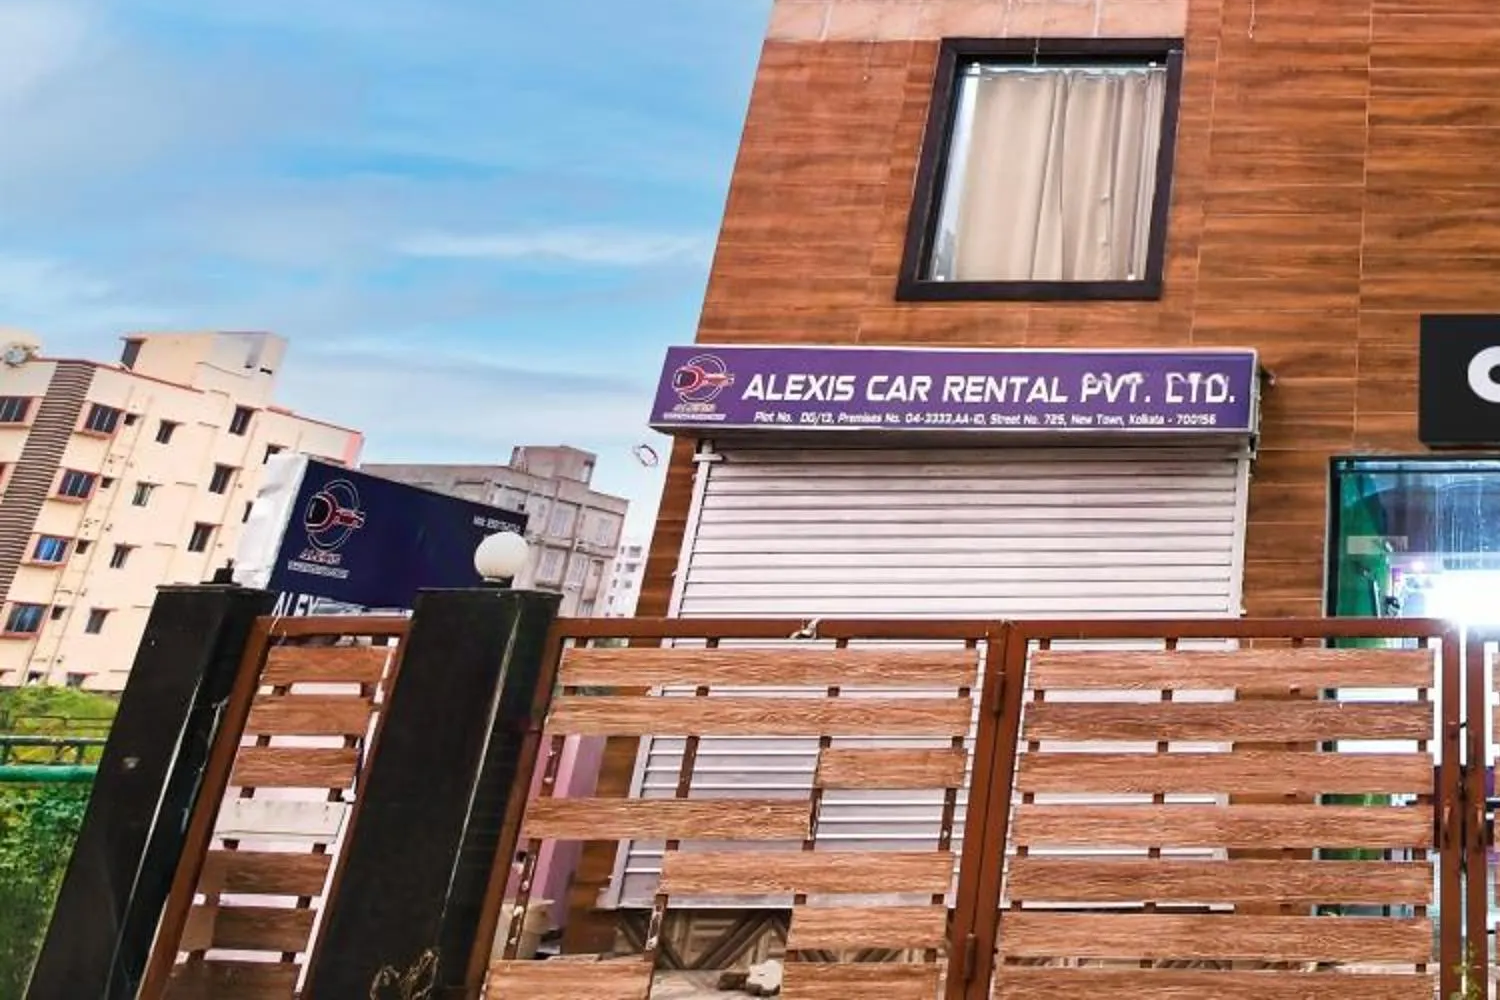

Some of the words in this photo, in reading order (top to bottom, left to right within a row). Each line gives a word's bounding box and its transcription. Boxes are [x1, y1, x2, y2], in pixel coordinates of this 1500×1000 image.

[742, 373, 857, 401] ALEXIS
[866, 374, 933, 403] CAR
[942, 375, 1069, 403] RENTAL
[1080, 371, 1150, 403] PVT.
[1071, 413, 1094, 425] New
